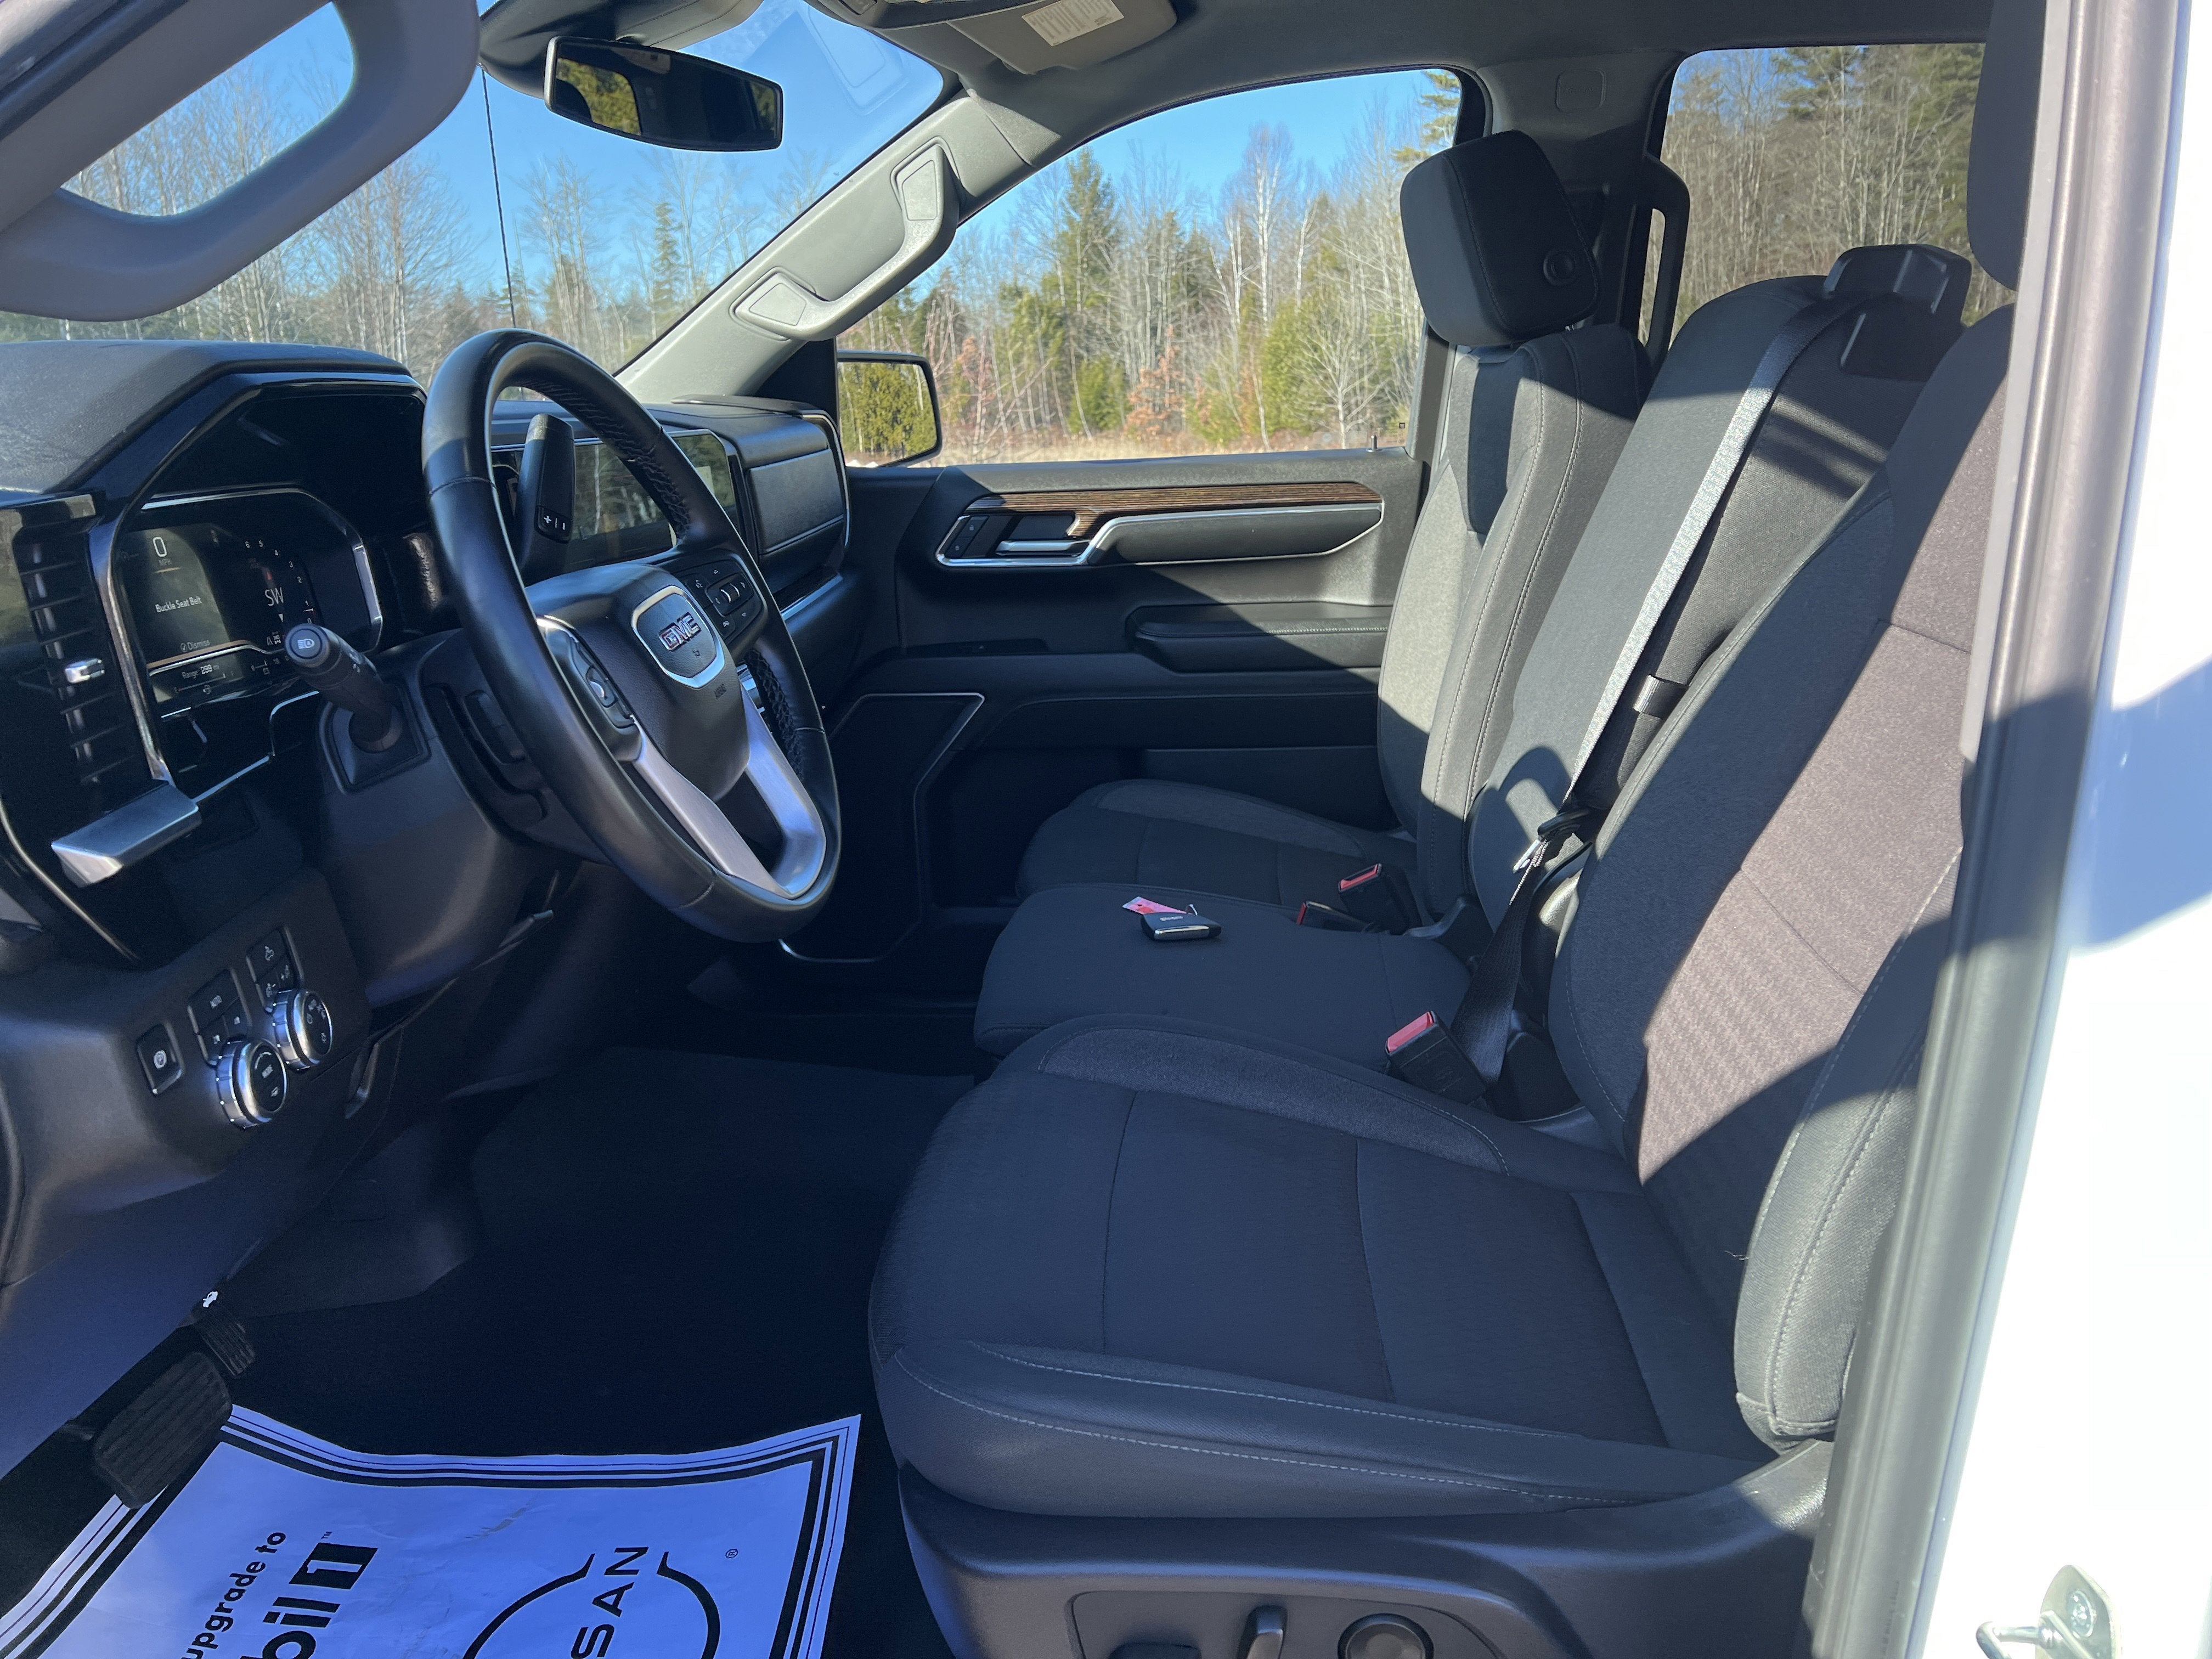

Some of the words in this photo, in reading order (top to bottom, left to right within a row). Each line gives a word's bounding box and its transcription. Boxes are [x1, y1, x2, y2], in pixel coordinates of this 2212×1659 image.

[153, 536, 167, 557] 0
[155, 601, 177, 613] Buckle
[176, 599, 190, 608] Seat
[189, 596, 202, 606] Belt
[264, 586, 284, 606] SW
[658, 612, 701, 652] GMC
[187, 640, 210, 650] Dismiss
[180, 1561, 267, 1659] upgrade
[255, 1532, 286, 1554] to
